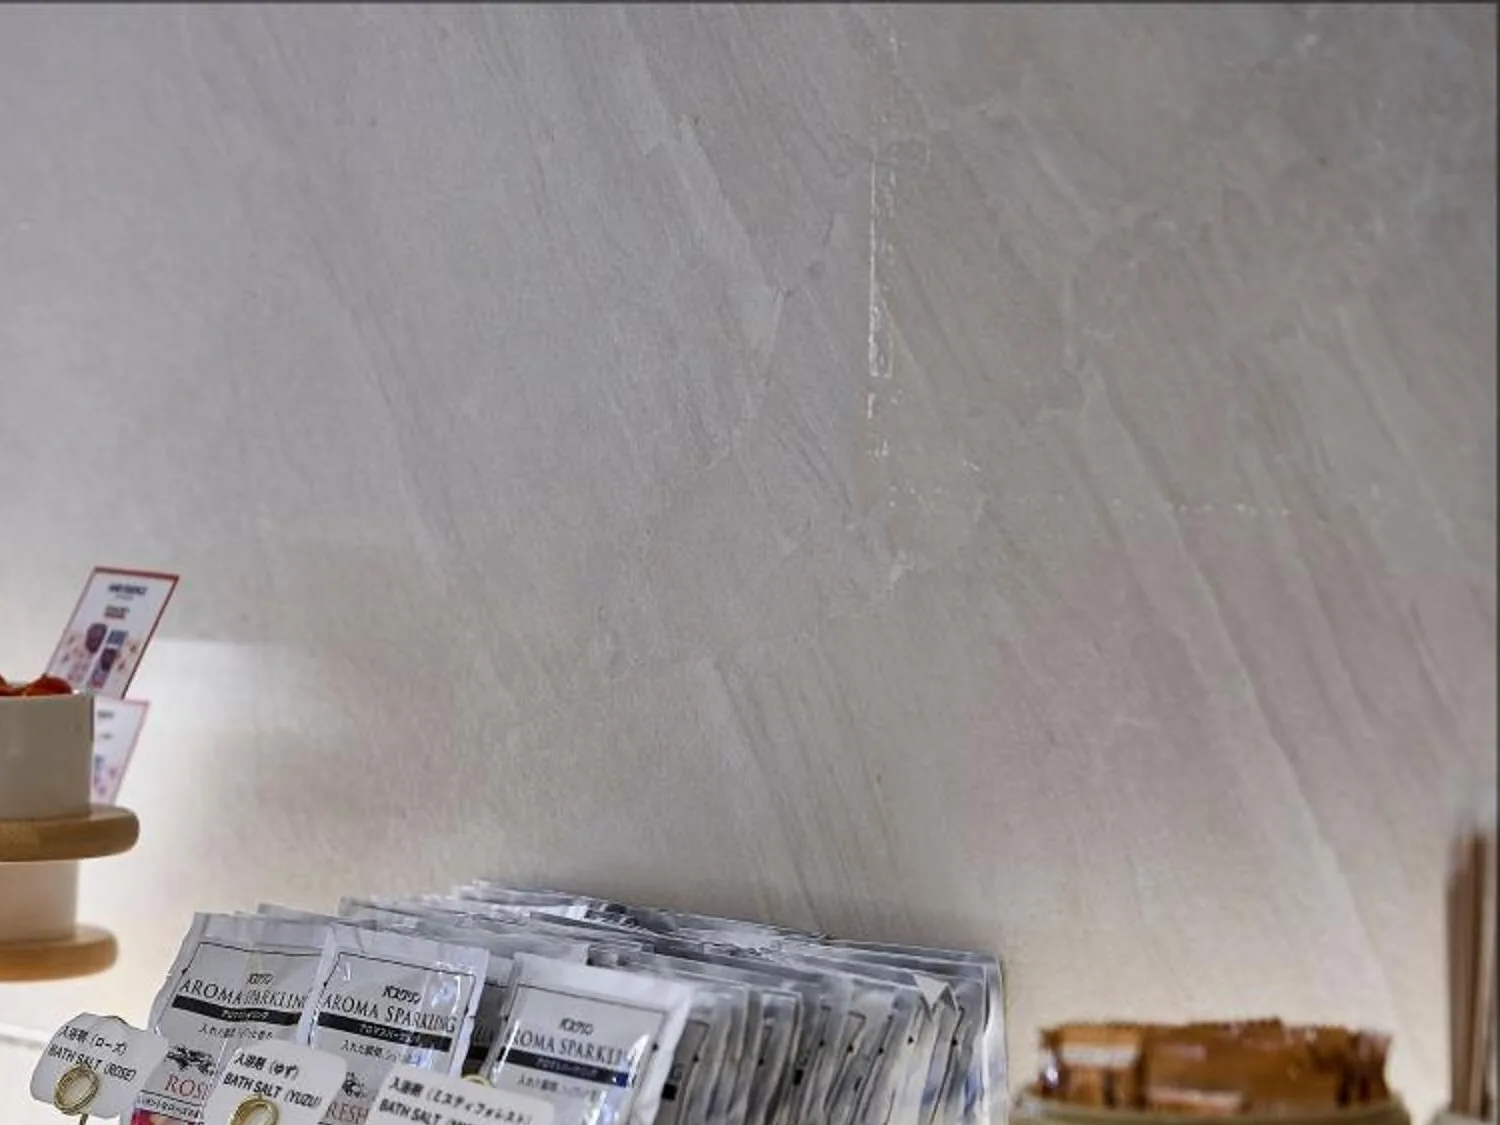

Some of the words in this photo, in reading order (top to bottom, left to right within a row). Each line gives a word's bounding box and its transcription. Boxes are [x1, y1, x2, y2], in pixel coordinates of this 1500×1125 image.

[179, 978, 243, 1006] AROMA
[319, 992, 379, 1020] AROMA
[48, 1043, 75, 1063] BATH
[75, 1052, 103, 1071] SALT
[223, 1071, 254, 1091] BATH
[253, 1080, 283, 1099] SALT
[325, 1100, 372, 1125] RESH
[379, 1097, 411, 1118] BATH
[411, 1106, 443, 1125] SALT
